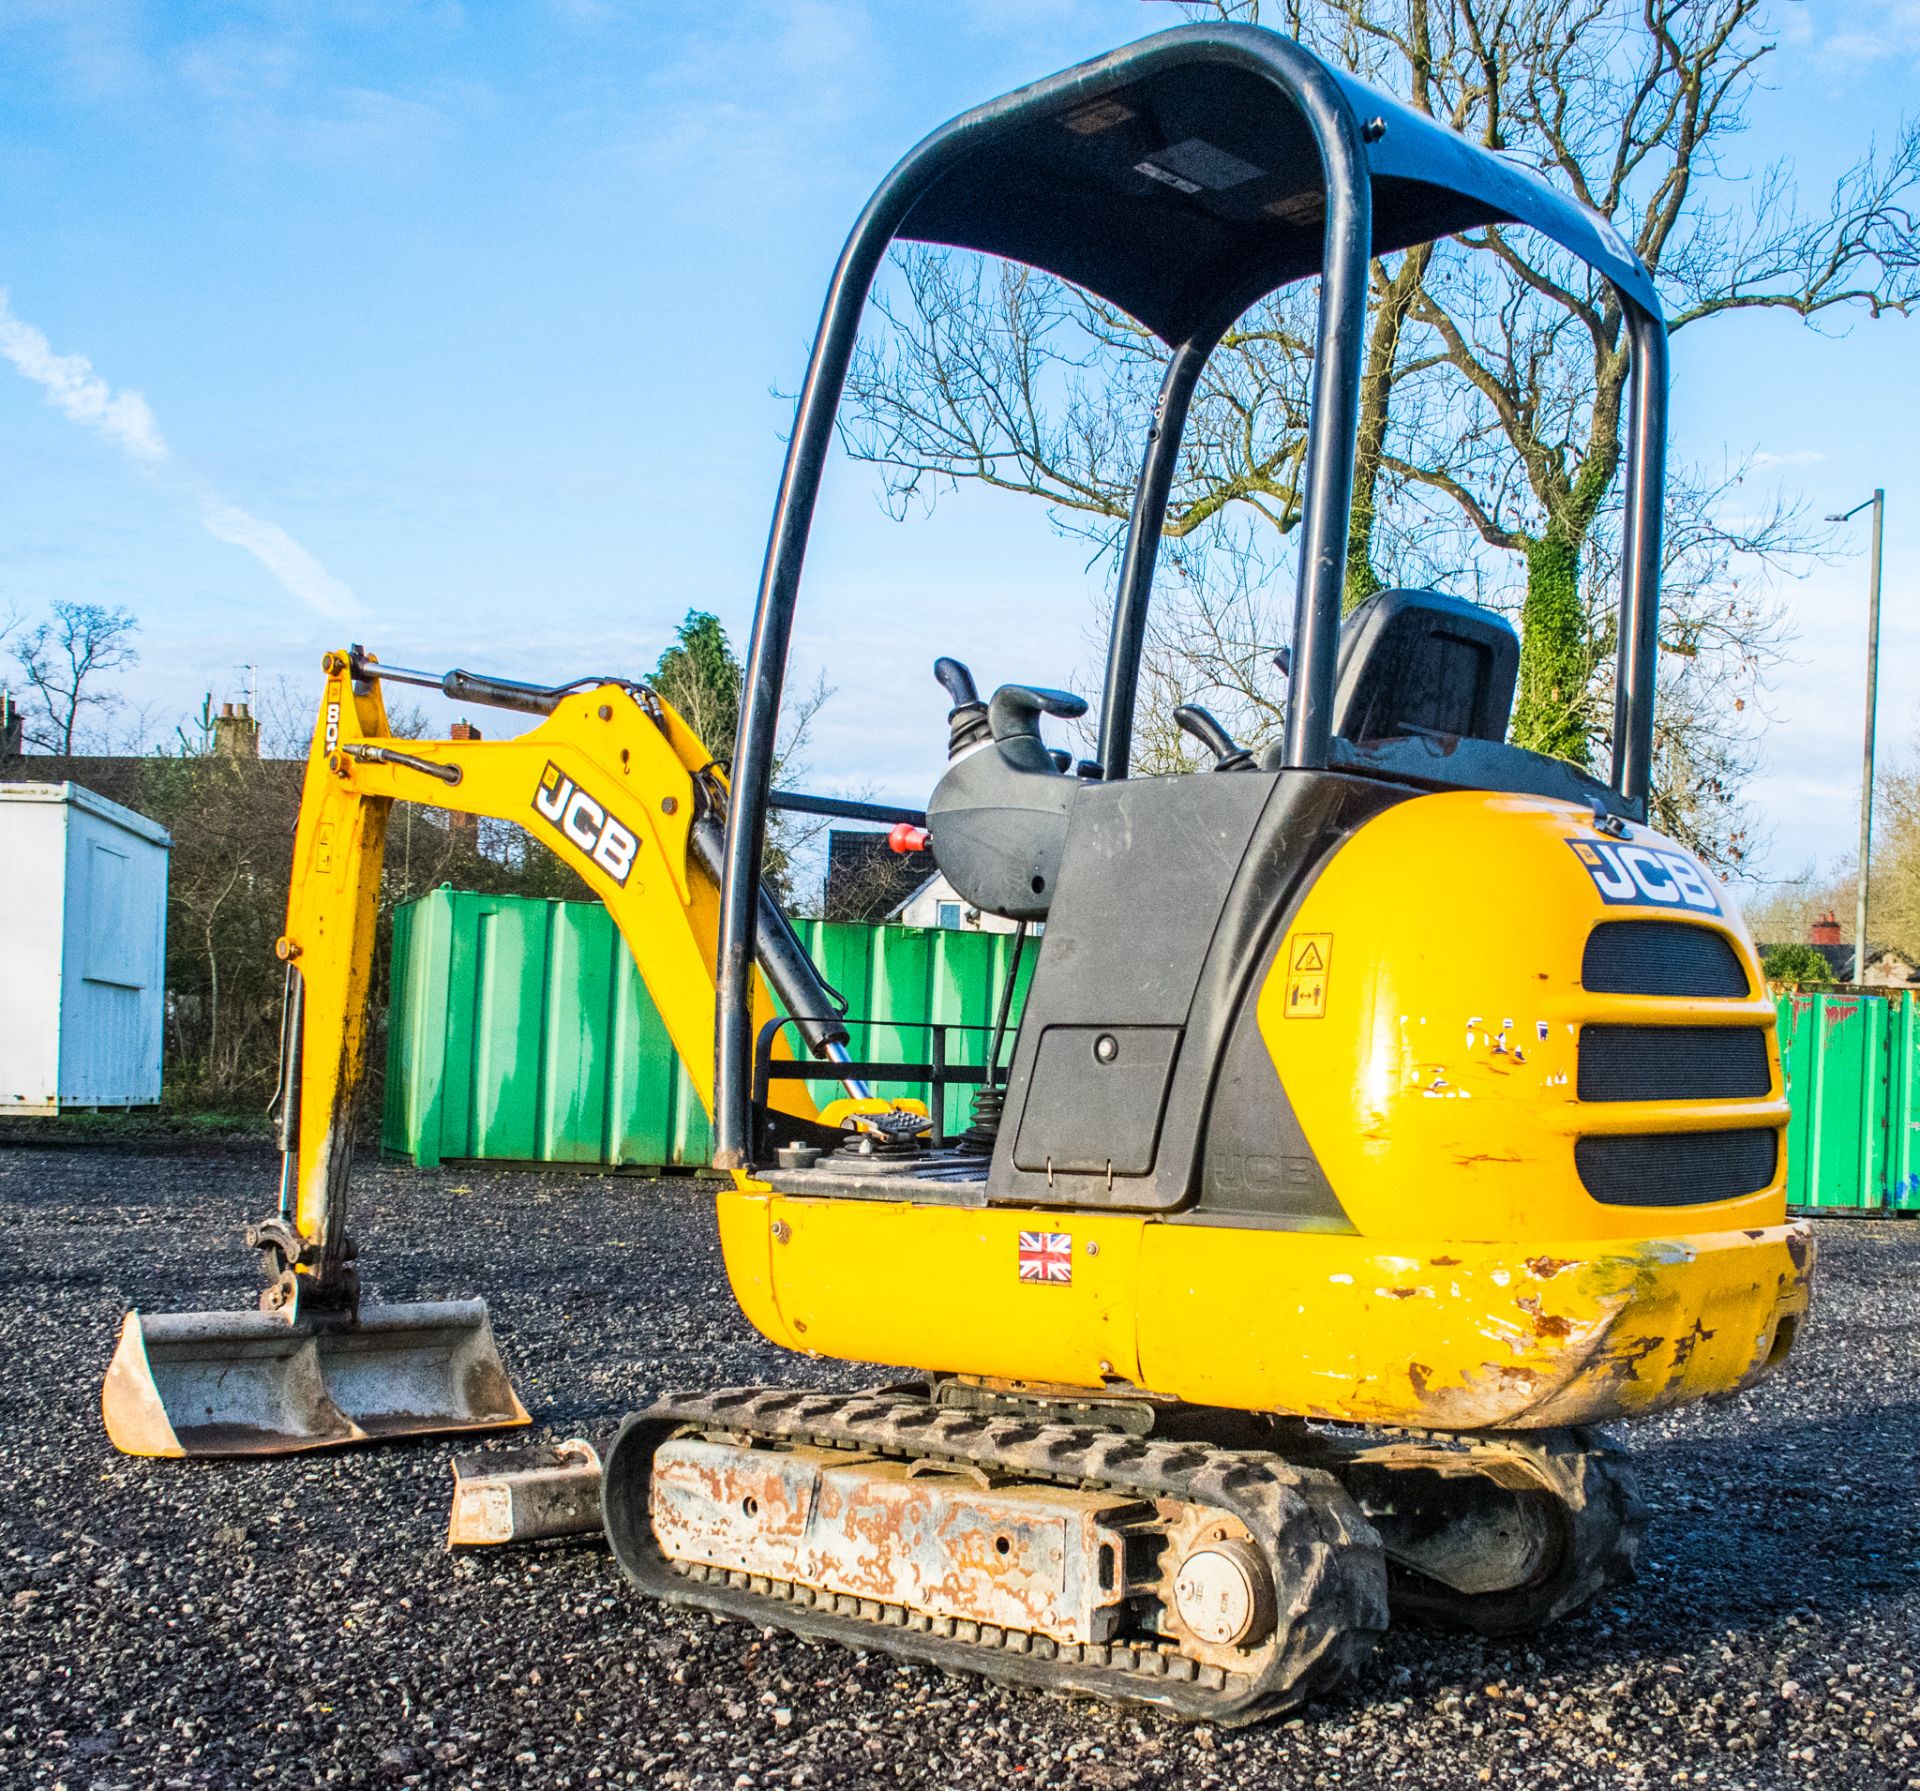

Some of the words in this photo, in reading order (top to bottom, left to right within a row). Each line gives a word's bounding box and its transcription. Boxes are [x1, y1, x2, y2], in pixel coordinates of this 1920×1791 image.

[536, 778, 638, 881] JCB
[1592, 844, 1717, 909] JCB
[1214, 1152, 1316, 1194] JCB
